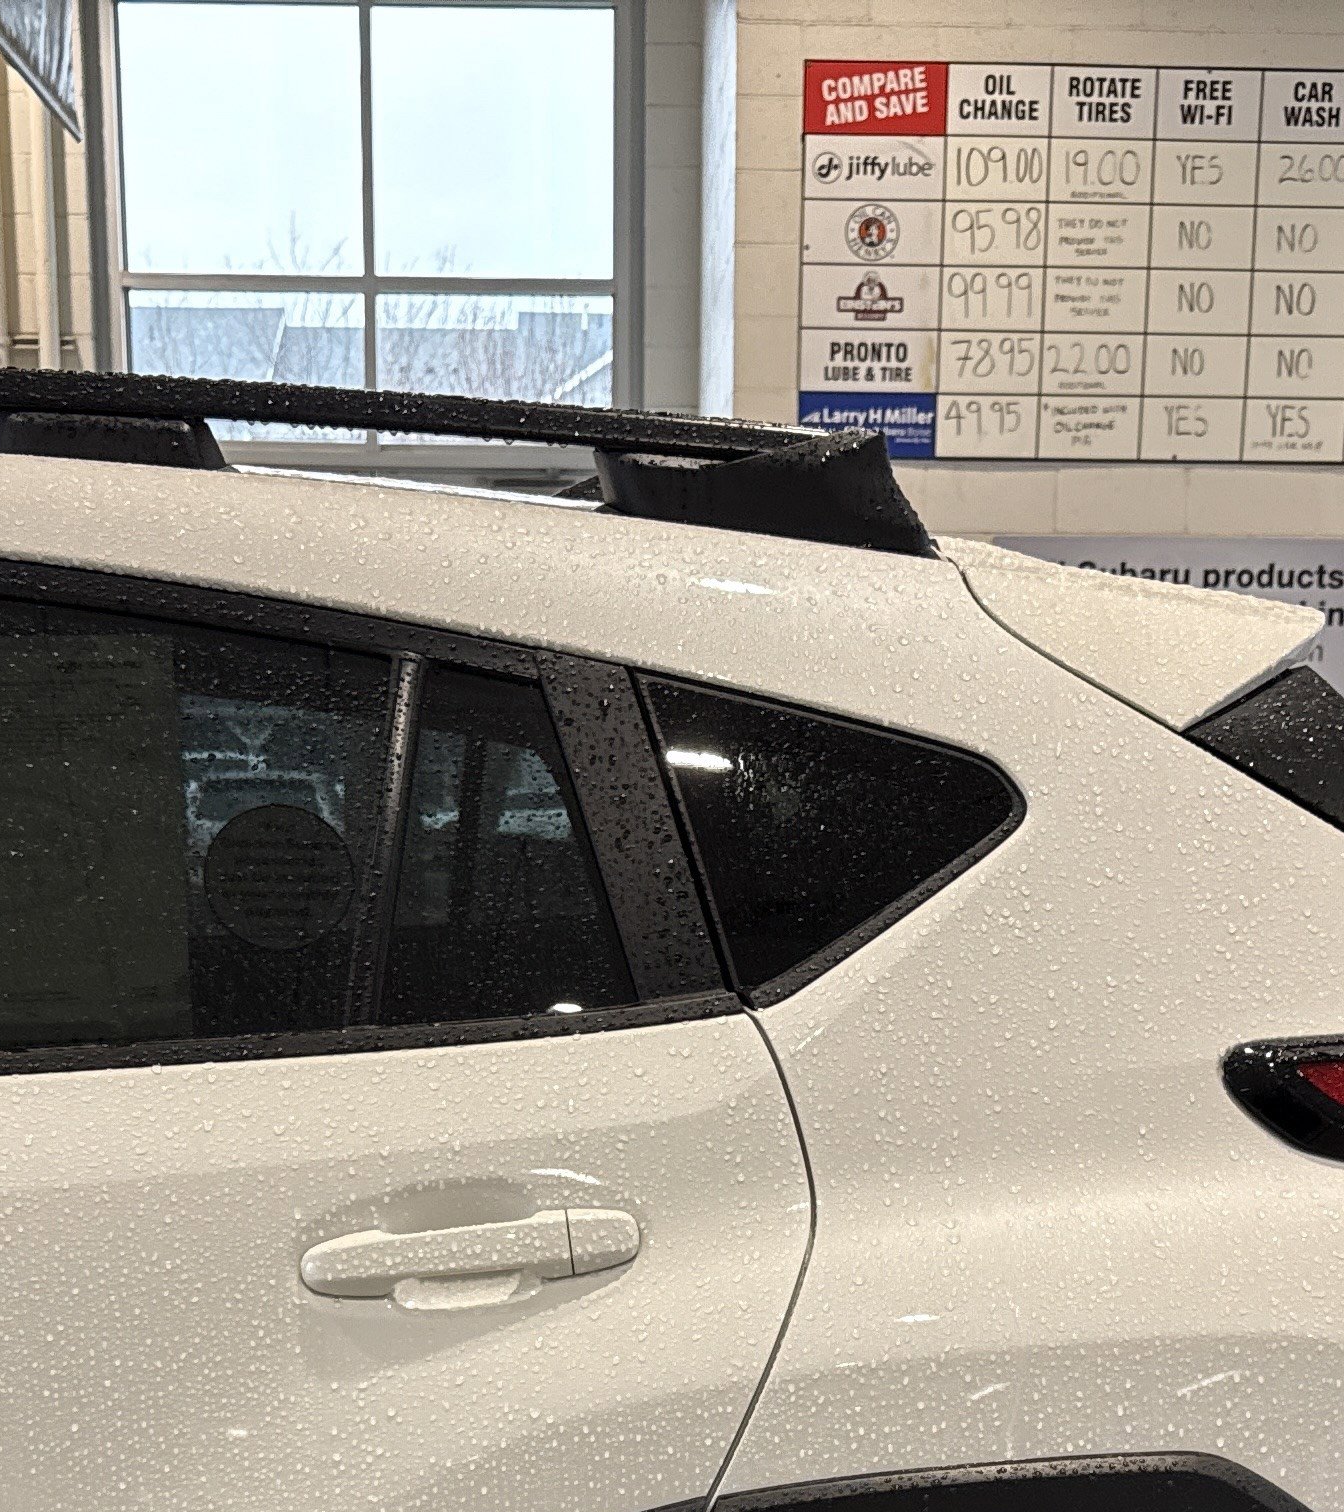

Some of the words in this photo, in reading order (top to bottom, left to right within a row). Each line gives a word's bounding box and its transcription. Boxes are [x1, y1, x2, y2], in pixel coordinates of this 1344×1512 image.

[822, 67, 927, 100] COMPARE
[984, 74, 1015, 95] OIL
[1068, 77, 1141, 98] ROTATE
[1183, 80, 1232, 100] FREE
[1293, 81, 1333, 102] CAR
[824, 99, 868, 126] AND
[874, 91, 929, 120] SAVE
[959, 99, 1039, 121] CHANGE
[1076, 102, 1131, 123] TIRES
[1181, 105, 1232, 126] WI-FI
[1284, 106, 1340, 128] WASH
[1176, 154, 1222, 185] YES
[1178, 221, 1212, 251] NO
[1276, 223, 1318, 253] NO
[1177, 282, 1214, 314] NO
[1275, 282, 1317, 316] NO
[830, 342, 908, 363] PRONTO
[1171, 348, 1204, 376] NO
[1277, 348, 1313, 379] NO
[823, 366, 860, 382] LUBE
[864, 367, 877, 381] &
[880, 367, 912, 382] TIRE
[823, 408, 866, 426] Larry
[868, 409, 882, 424] H
[884, 407, 934, 424] Miller
[1164, 405, 1208, 438] YES
[1266, 404, 1310, 438] YES
[1079, 561, 1189, 584] baru
[1203, 563, 1344, 588] products
